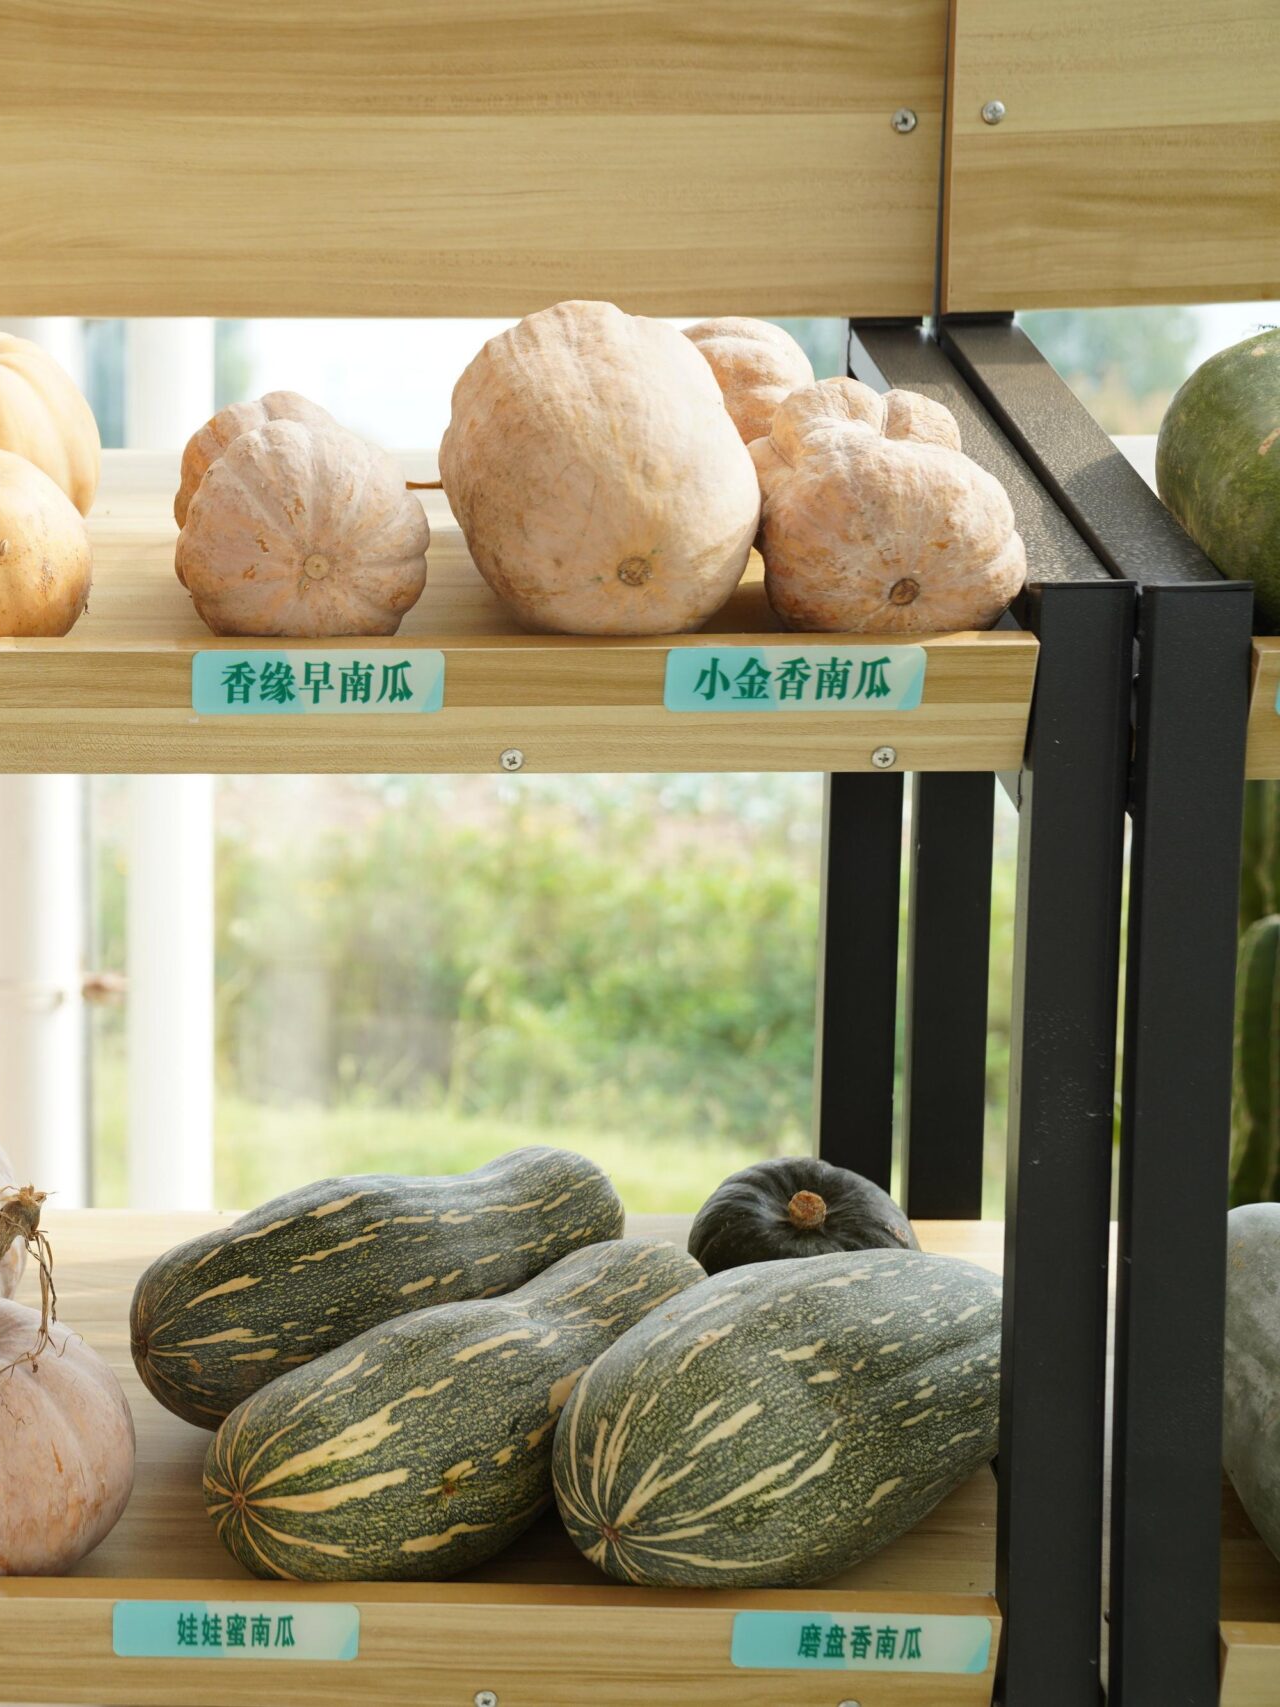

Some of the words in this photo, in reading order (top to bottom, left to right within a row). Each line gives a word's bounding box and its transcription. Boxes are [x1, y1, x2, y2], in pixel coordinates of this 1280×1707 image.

[220, 660, 414, 705] 香缘早南瓜
[692, 656, 892, 702] 小金香南瓜
[176, 1612, 296, 1648] 娃娃蜜南瓜
[796, 1622, 922, 1660] 磨盘香南瓜
